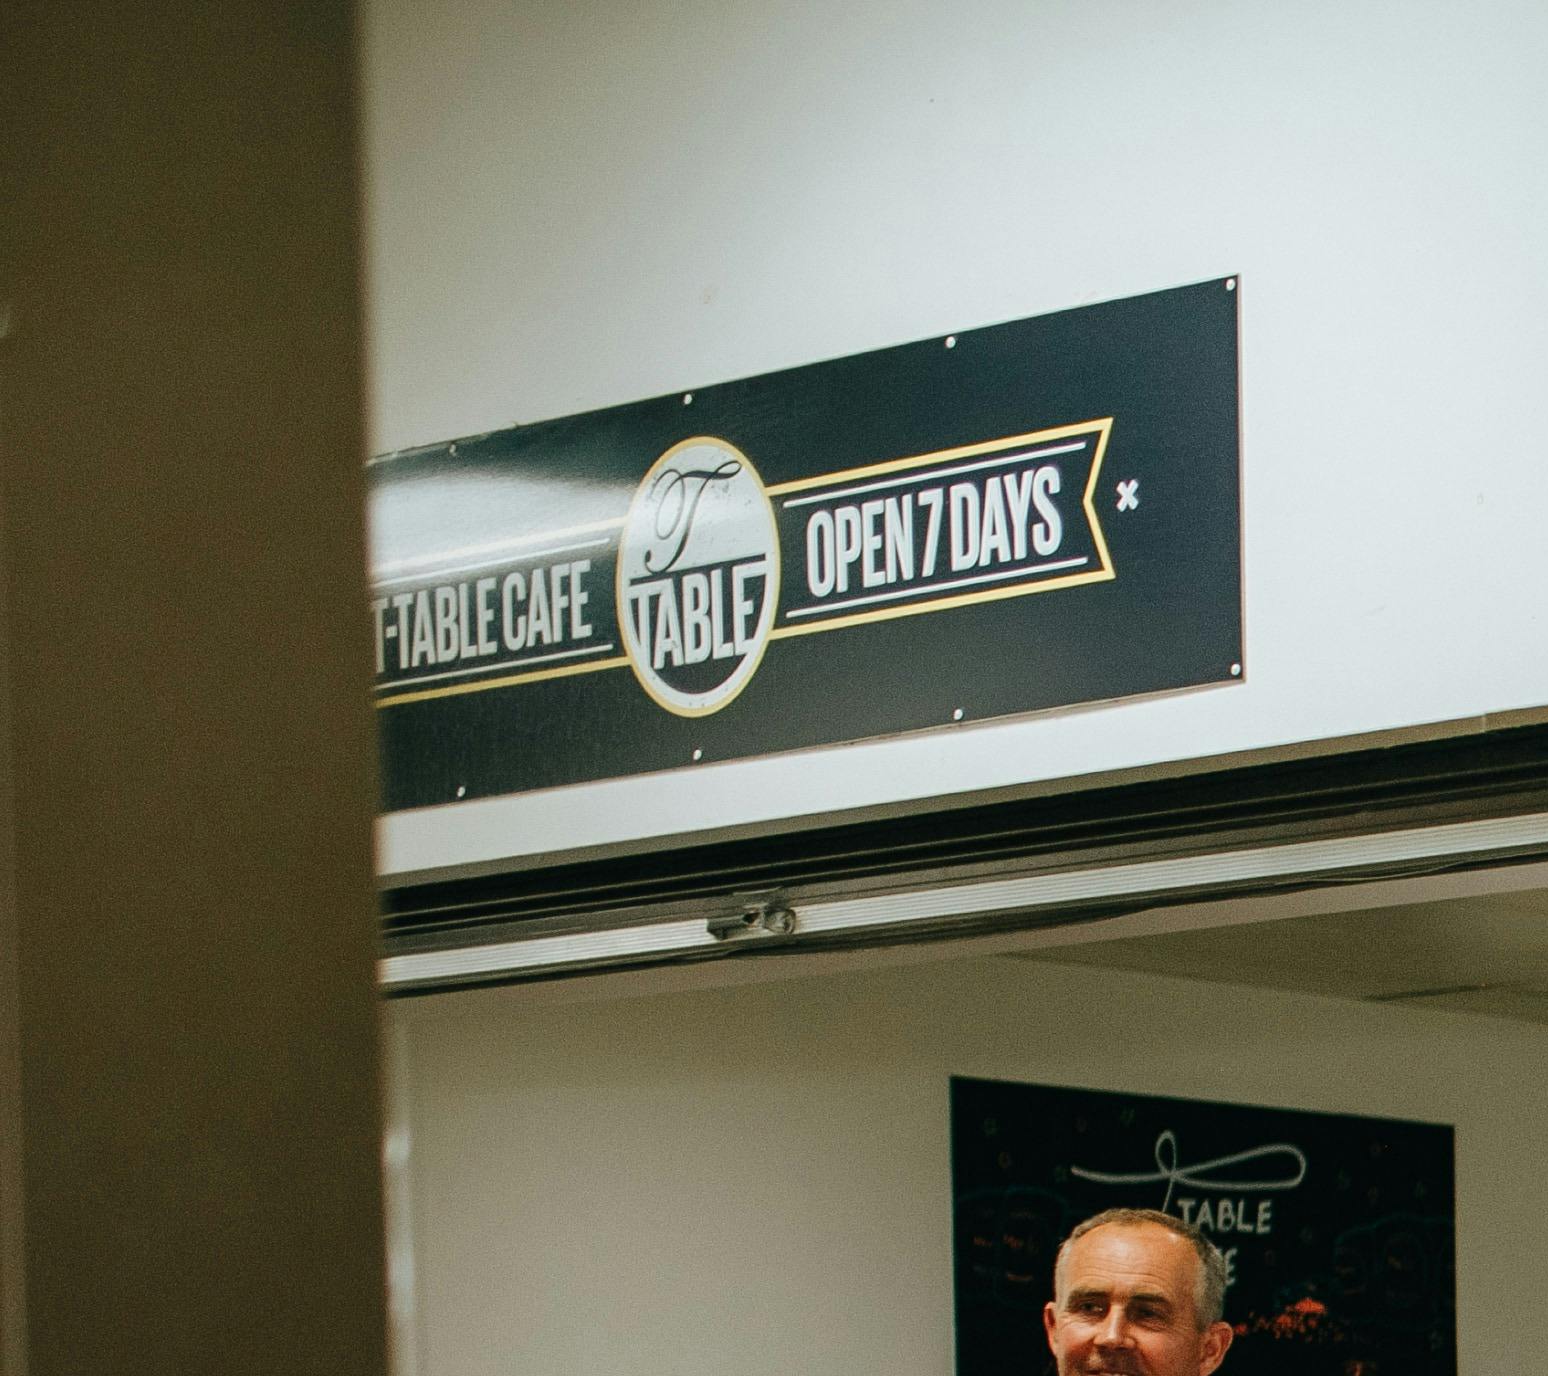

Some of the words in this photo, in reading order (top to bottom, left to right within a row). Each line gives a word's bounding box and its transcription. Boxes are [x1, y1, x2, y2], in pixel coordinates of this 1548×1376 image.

[645, 460, 742, 573] T
[807, 496, 913, 599] OPEN
[917, 488, 942, 579] 7
[951, 465, 1064, 571] DAYS
[373, 577, 498, 673] T-TABLE
[502, 559, 593, 652] CAFE
[629, 560, 767, 670] TABLE
[1177, 1199, 1273, 1235] TABLE
